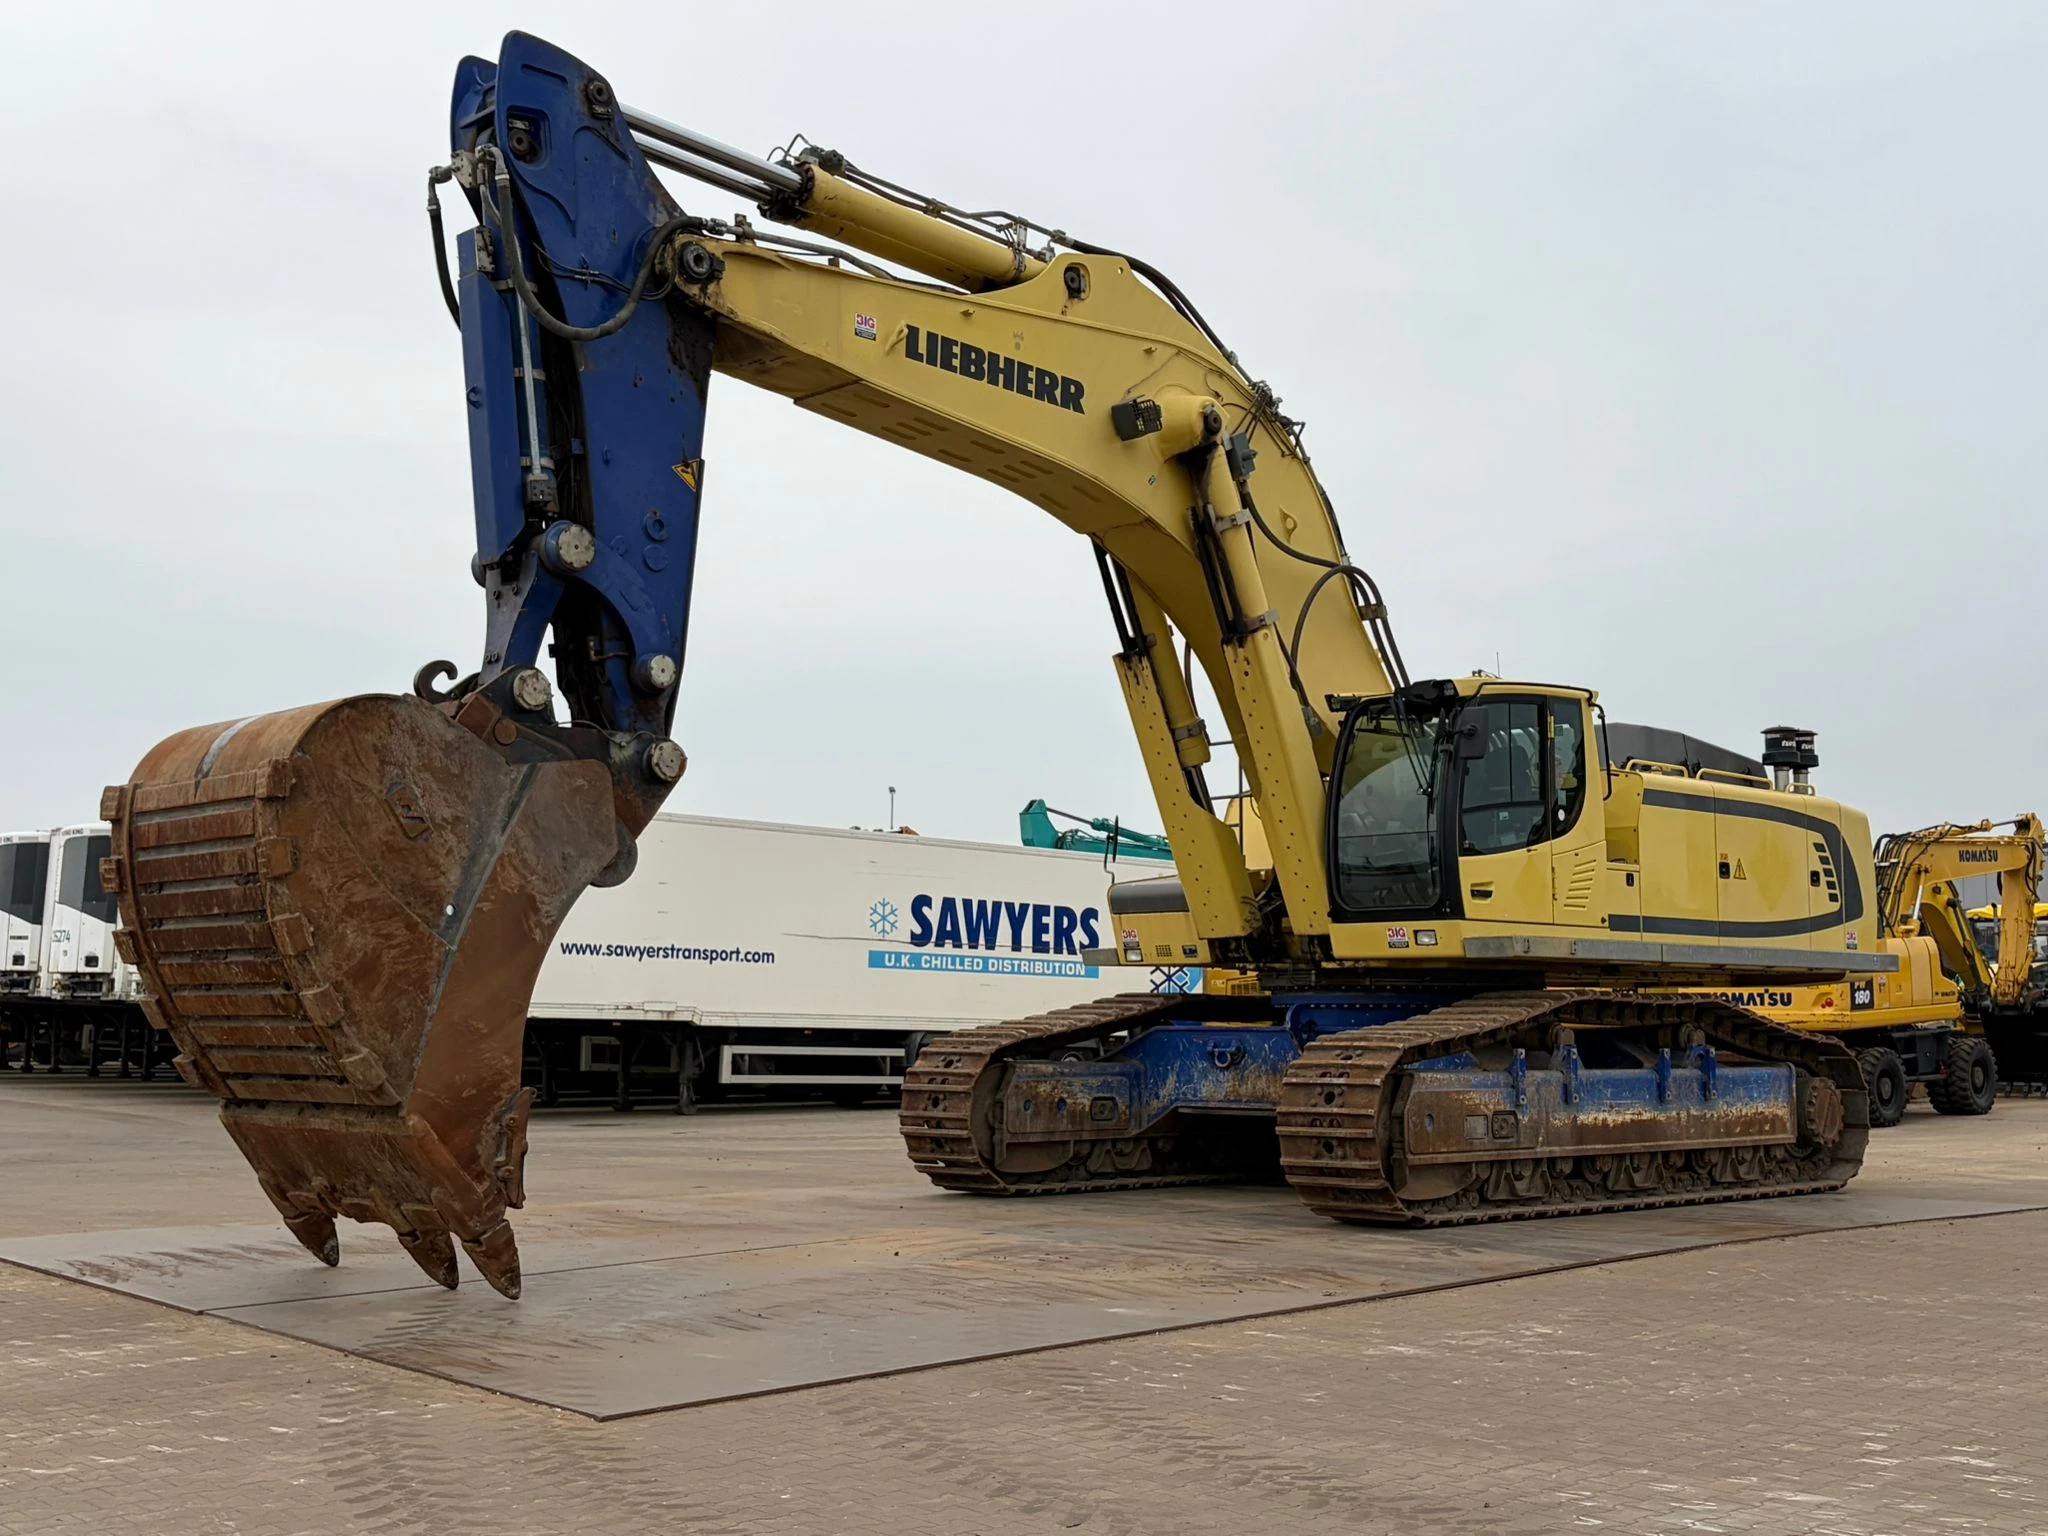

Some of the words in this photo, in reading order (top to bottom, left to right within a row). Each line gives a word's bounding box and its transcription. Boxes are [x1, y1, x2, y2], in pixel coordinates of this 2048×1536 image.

[905, 323, 1086, 415] LIEBHERR
[1959, 846, 1998, 862] KOMATSU
[910, 894, 1099, 955] SAWYERS
[560, 942, 775, 964] www.sawyerstransport.com
[884, 953, 915, 968] U.K.
[921, 956, 982, 971] CHILLED
[988, 959, 1086, 975] DISTRIBUTION
[1714, 986, 1792, 1007] OMATSU
[1855, 990, 1870, 1004] 180
